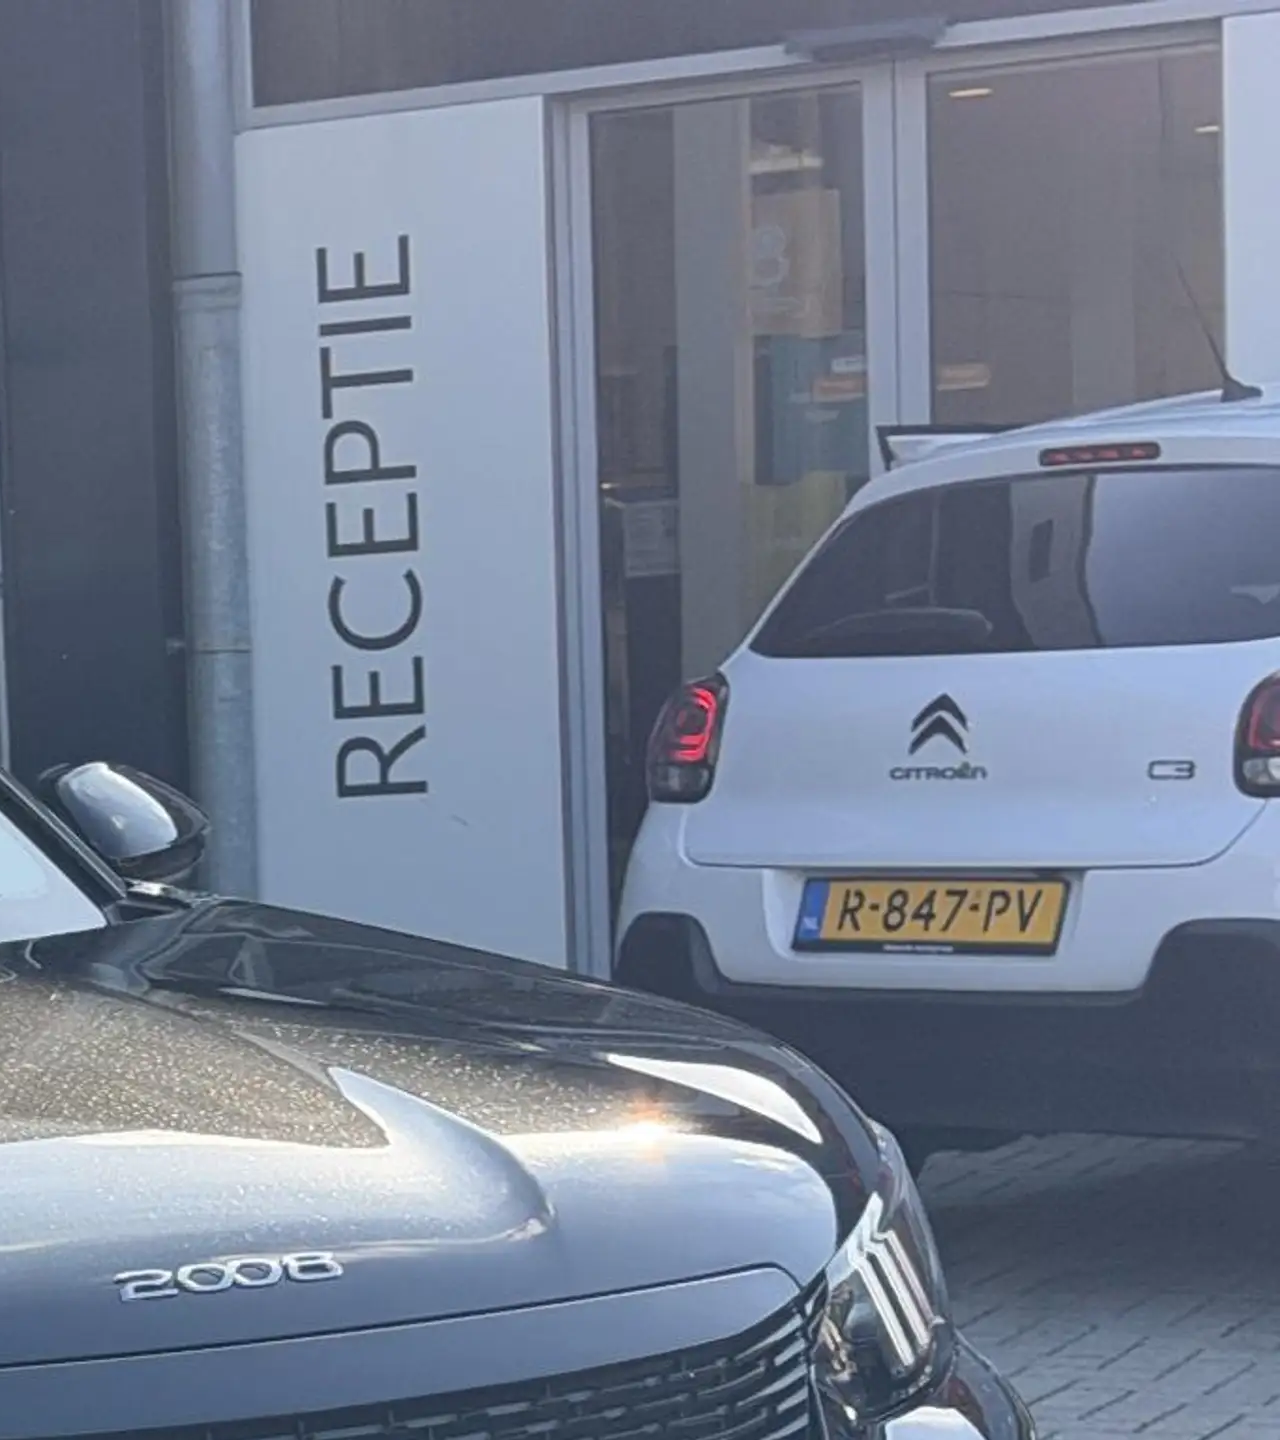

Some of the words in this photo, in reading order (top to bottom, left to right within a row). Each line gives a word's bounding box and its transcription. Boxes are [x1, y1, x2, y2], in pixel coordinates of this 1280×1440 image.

[315, 233, 429, 799] RECEPTIE
[1146, 759, 1197, 780] C3
[836, 888, 1044, 933] R-847-PV
[113, 1251, 345, 1302] 2008
